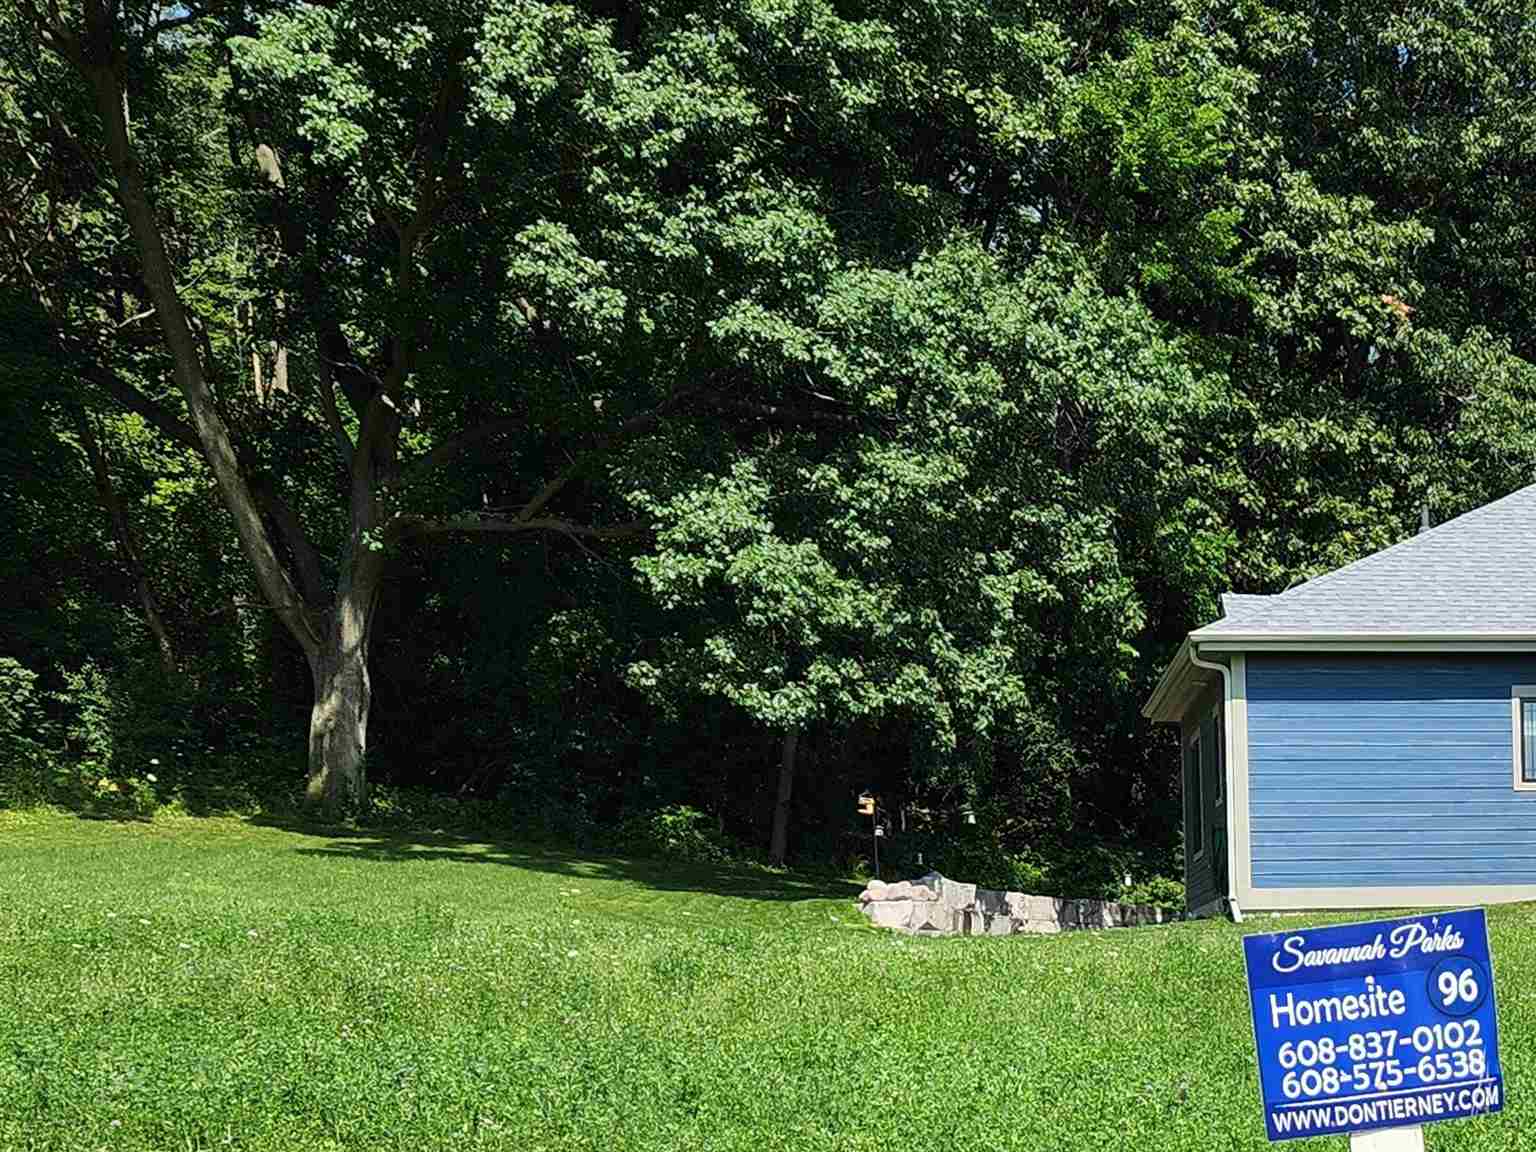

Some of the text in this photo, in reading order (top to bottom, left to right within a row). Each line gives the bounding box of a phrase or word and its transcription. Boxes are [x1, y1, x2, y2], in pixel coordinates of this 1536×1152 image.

[1272, 923, 1464, 972] Savannah Parks
[1269, 976, 1405, 1028] Homesite
[1437, 968, 1478, 1006] 96
[1278, 1019, 1482, 1069] 608-837-0102
[1282, 1049, 1486, 1098] 608-575-6538
[1272, 1086, 1499, 1132] WWW.DONTIERNEY.COM
